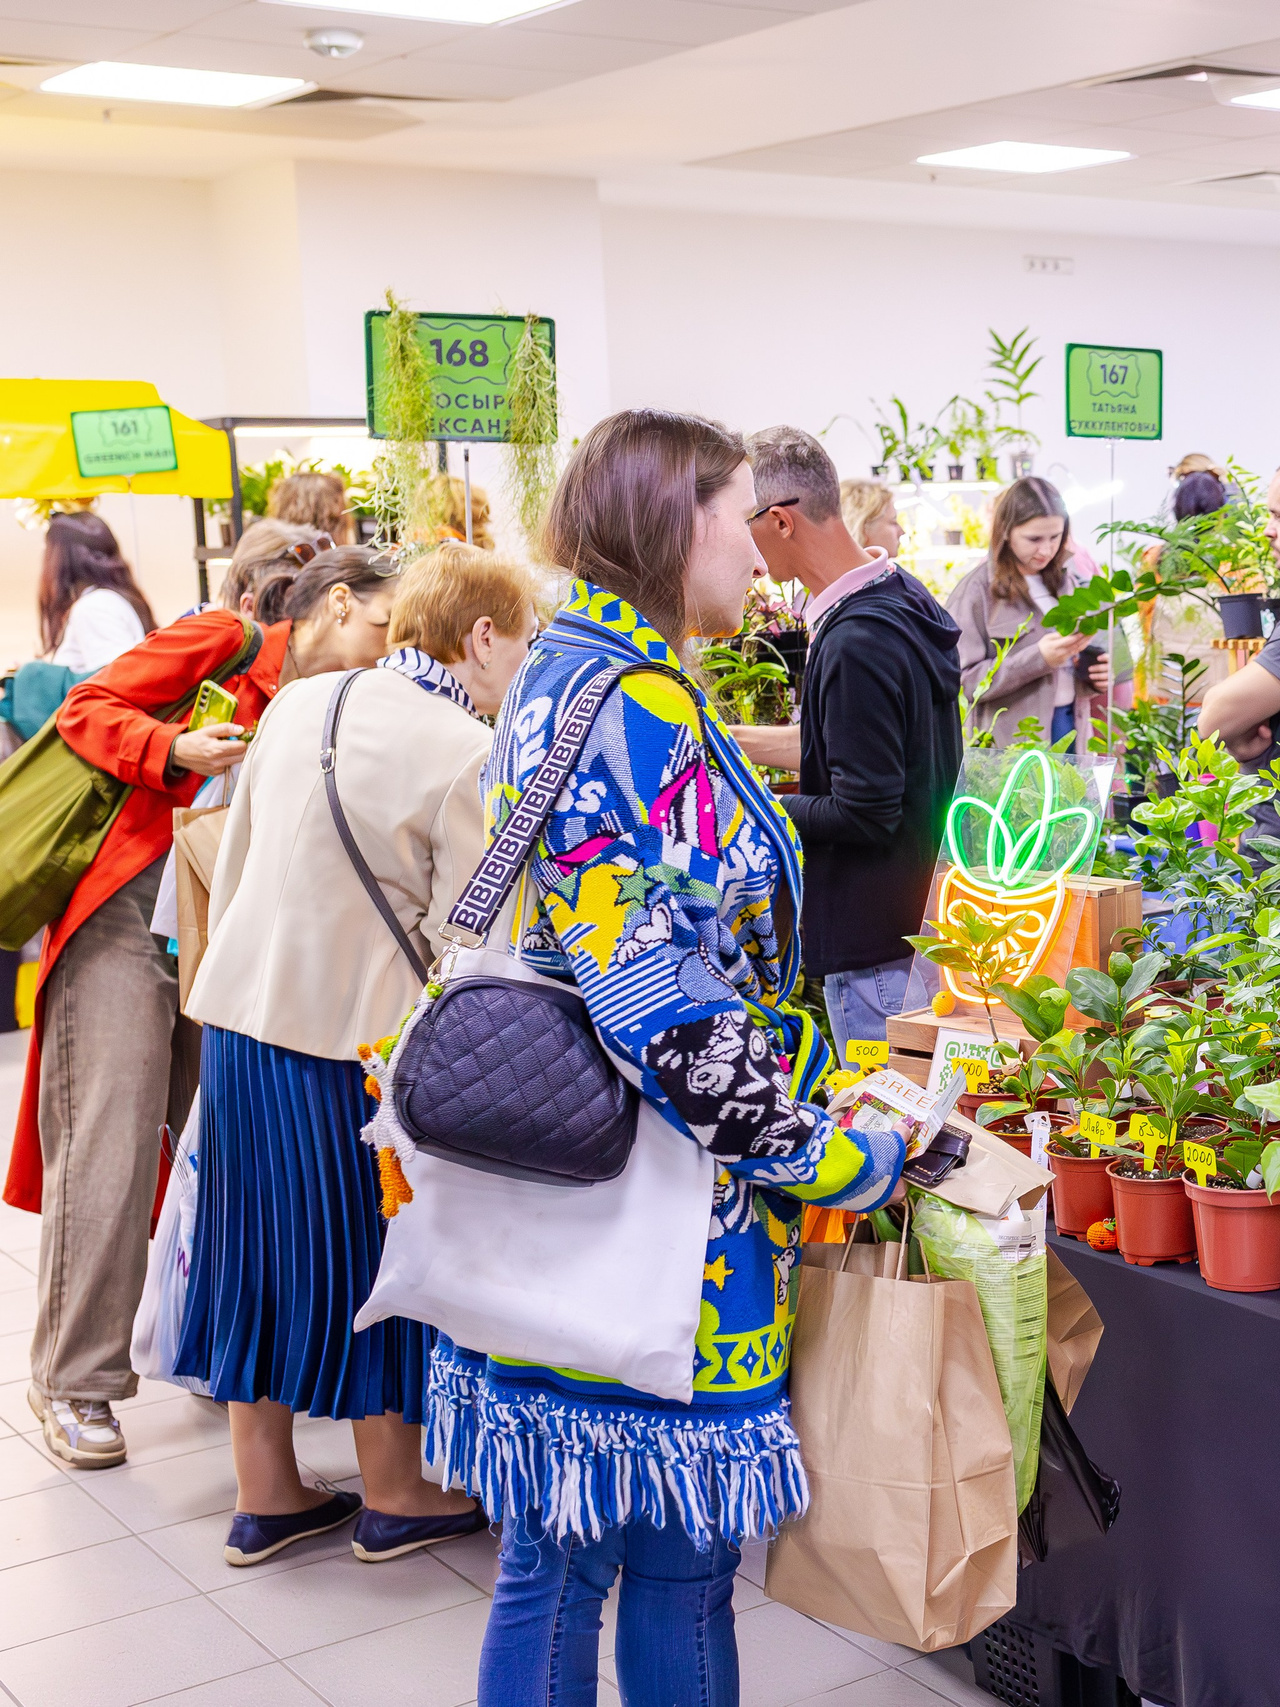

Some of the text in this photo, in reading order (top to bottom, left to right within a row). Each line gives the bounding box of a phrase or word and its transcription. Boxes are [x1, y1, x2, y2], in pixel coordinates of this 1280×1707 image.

[430, 338, 489, 367] 168
[1100, 364, 1129, 385] 167
[436, 393, 513, 409] ОСЫР
[1092, 402, 1137, 414] ТАТЬЯНА
[111, 419, 138, 436] 161
[1071, 420, 1157, 432] СУККУЛЕНТОВНА
[855, 1045, 879, 1057] 500
[874, 1071, 940, 1111] GREE
[1083, 1117, 1105, 1141] Лавр
[1187, 1147, 1213, 1166] 2000
